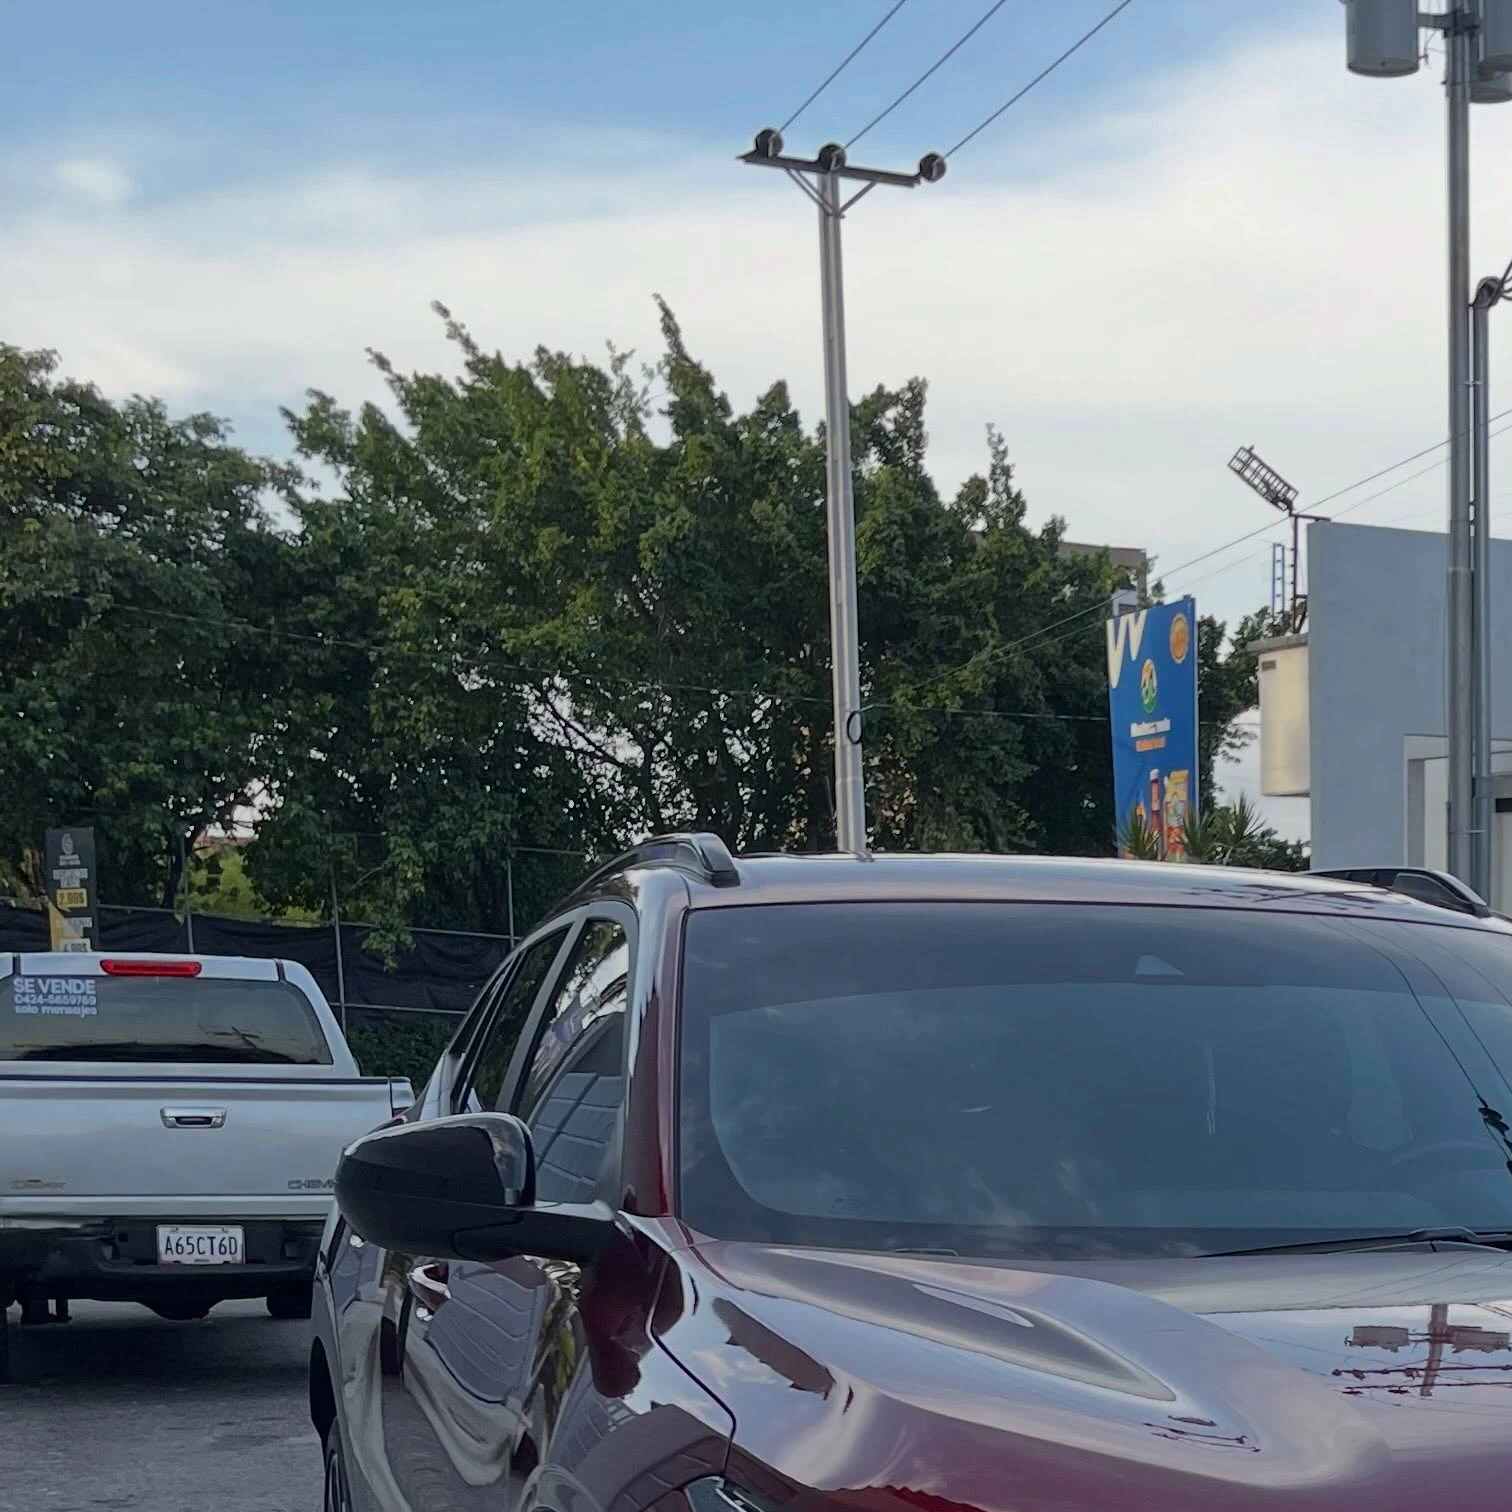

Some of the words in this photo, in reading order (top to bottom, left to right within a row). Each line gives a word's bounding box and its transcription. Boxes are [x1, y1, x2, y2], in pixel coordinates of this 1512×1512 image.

[13, 978, 35, 993] SE
[37, 979, 96, 994] VENDE
[165, 1235, 238, 1256] A65CT6D
